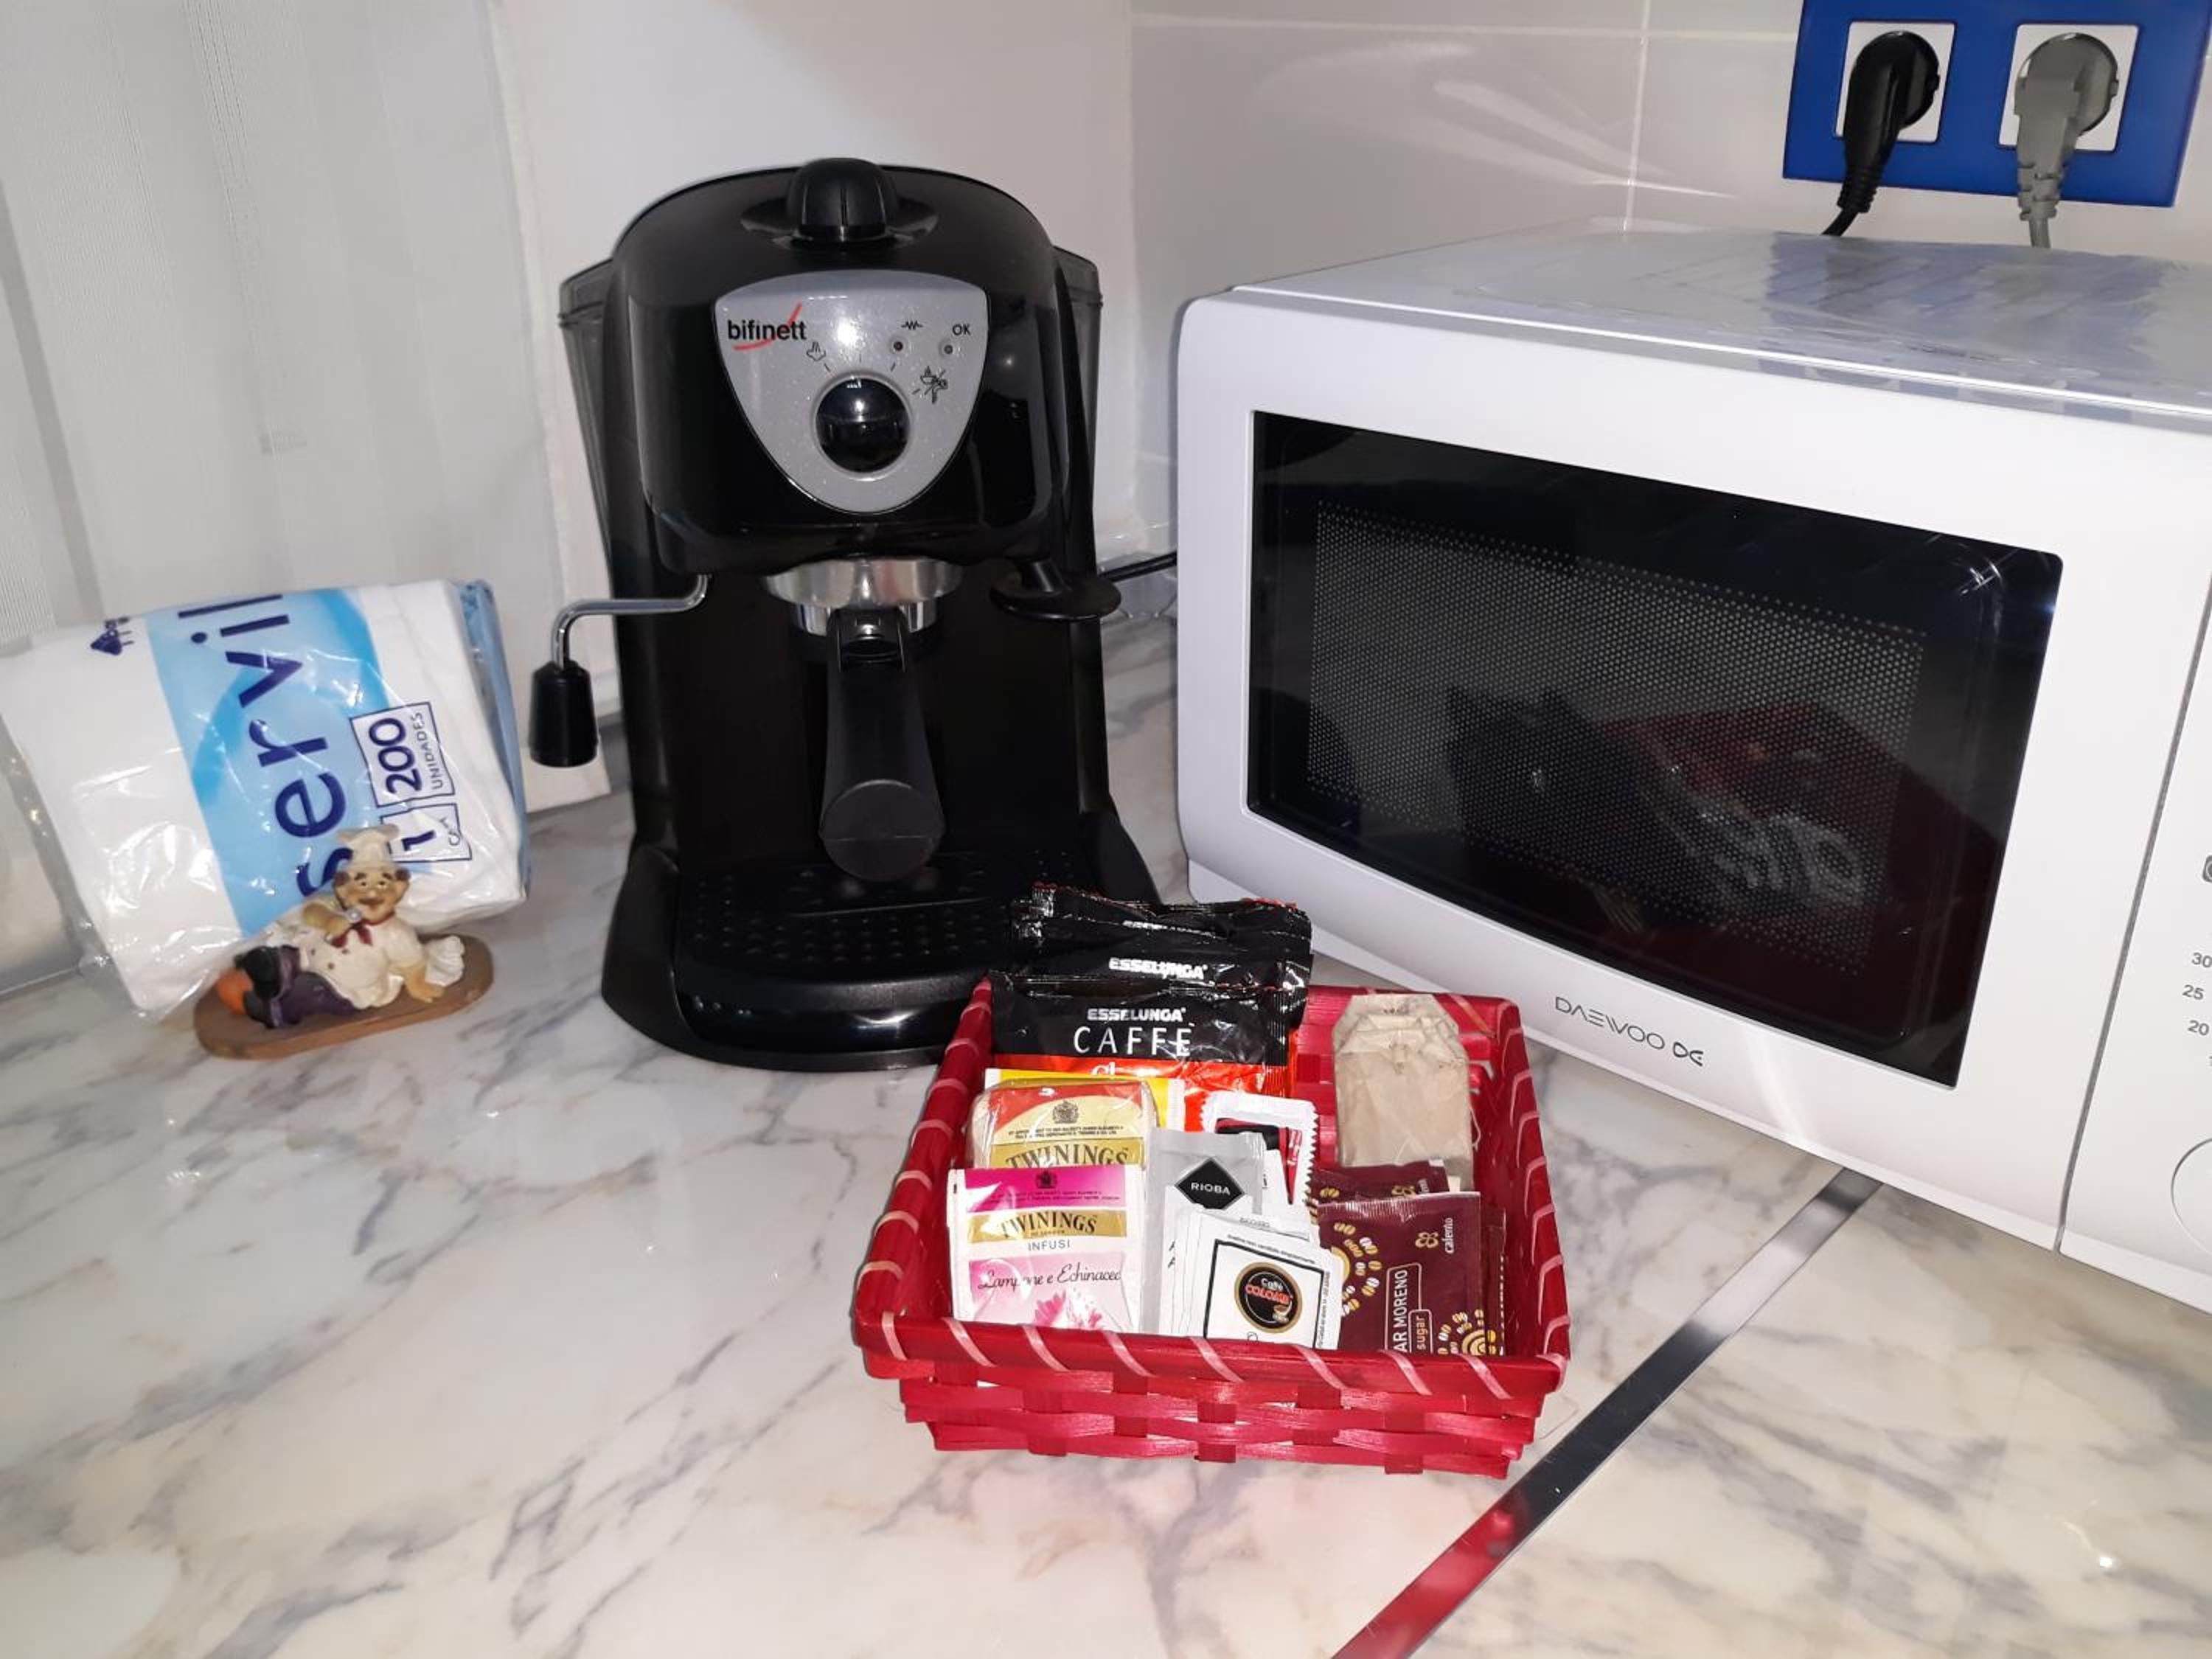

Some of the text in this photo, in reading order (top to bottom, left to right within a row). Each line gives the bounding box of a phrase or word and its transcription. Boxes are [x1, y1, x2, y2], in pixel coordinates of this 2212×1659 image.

[728, 320, 807, 341] bifinett
[953, 324, 971, 335] OK
[369, 717, 422, 794] 200
[411, 712, 443, 790] UNIDADES
[401, 830, 437, 852] 1
[1109, 957, 1206, 980] ESSELUNGA
[2192, 952, 2212, 968] 30
[2183, 984, 2205, 1001] 25
[1087, 1008, 1184, 1023] ESSELUNGA
[1555, 996, 1665, 1050] DAEWOO
[2188, 1020, 2210, 1036] 20
[1006, 1144, 1129, 1169] TWININGS
[1191, 1181, 1231, 1195] RIOBA
[998, 1211, 1098, 1239] TWININGS
[1027, 1239, 1071, 1251] INFUSI
[1393, 1269, 1408, 1328] MORENO
[1416, 1315, 1428, 1350] sugar
